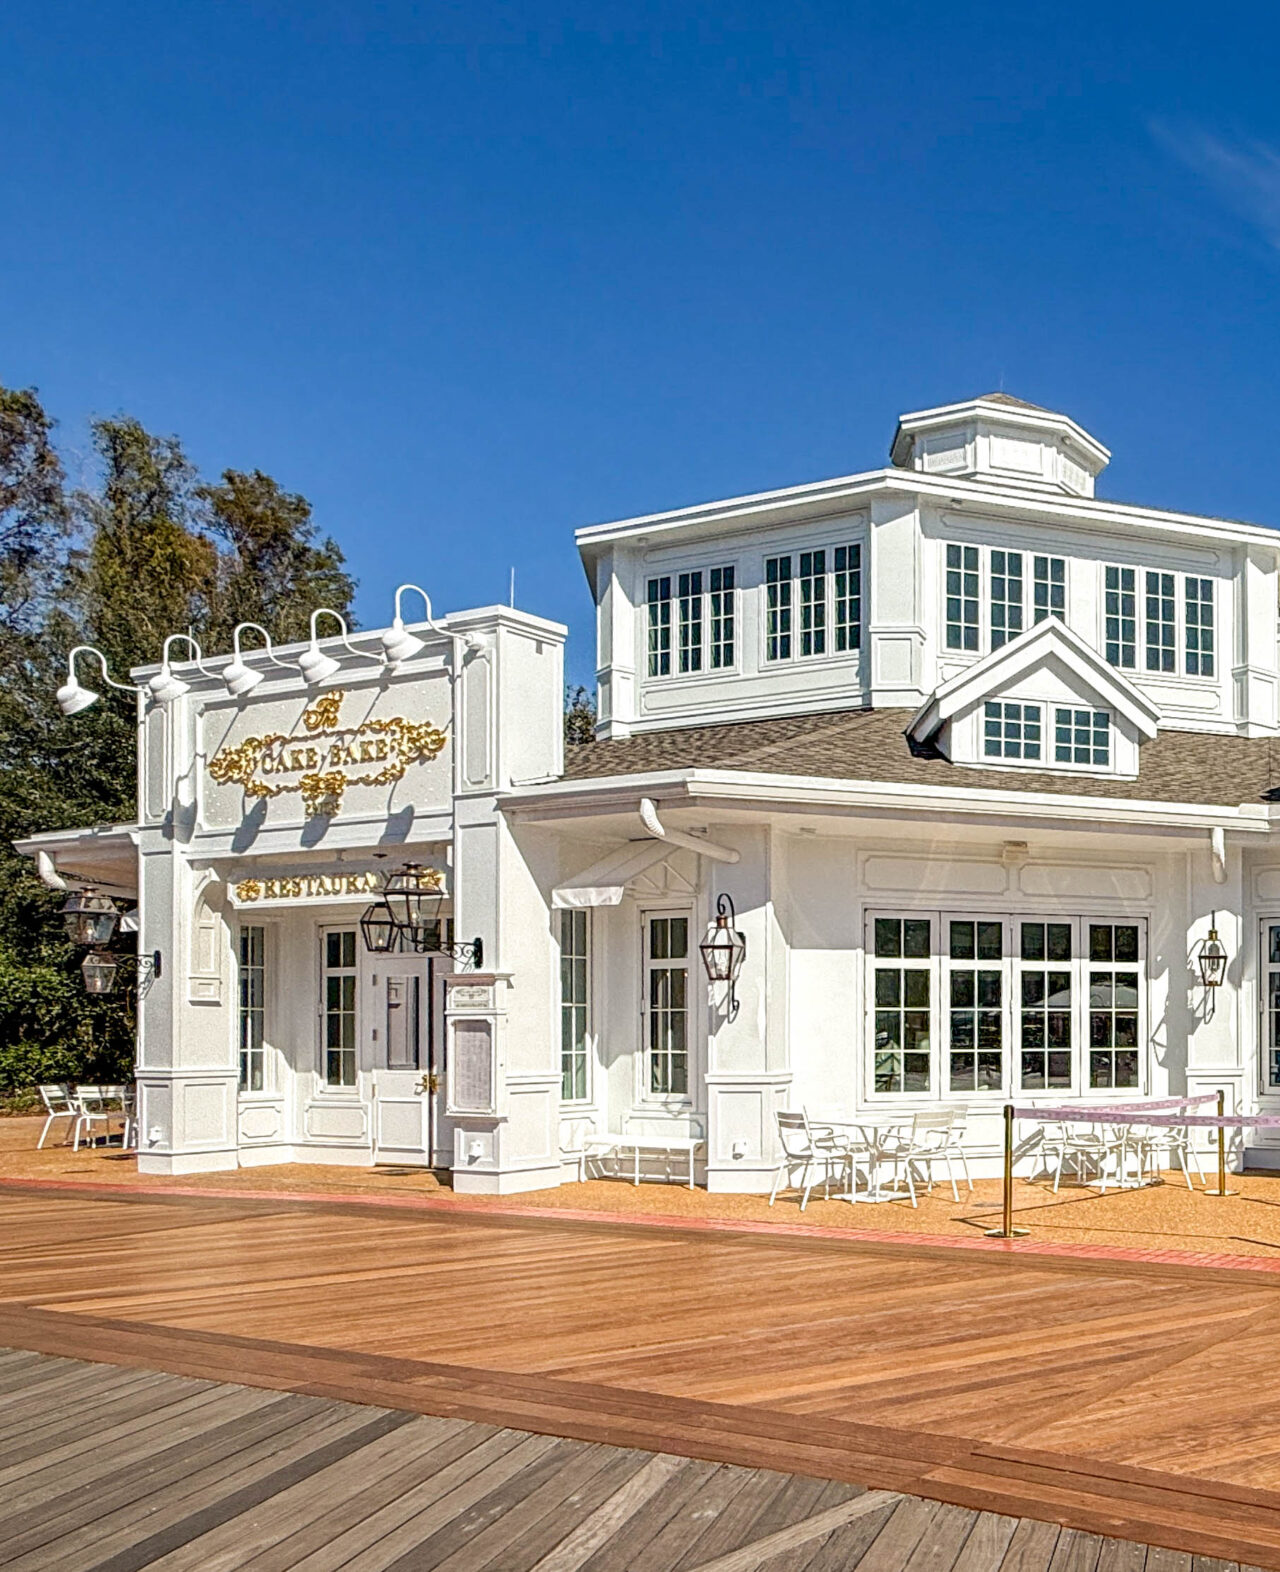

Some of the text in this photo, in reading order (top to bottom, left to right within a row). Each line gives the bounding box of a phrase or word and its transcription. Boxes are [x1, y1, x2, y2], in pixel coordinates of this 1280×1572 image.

[261, 739, 388, 775] CAKE BAKE
[264, 872, 398, 898] RESTAURA
